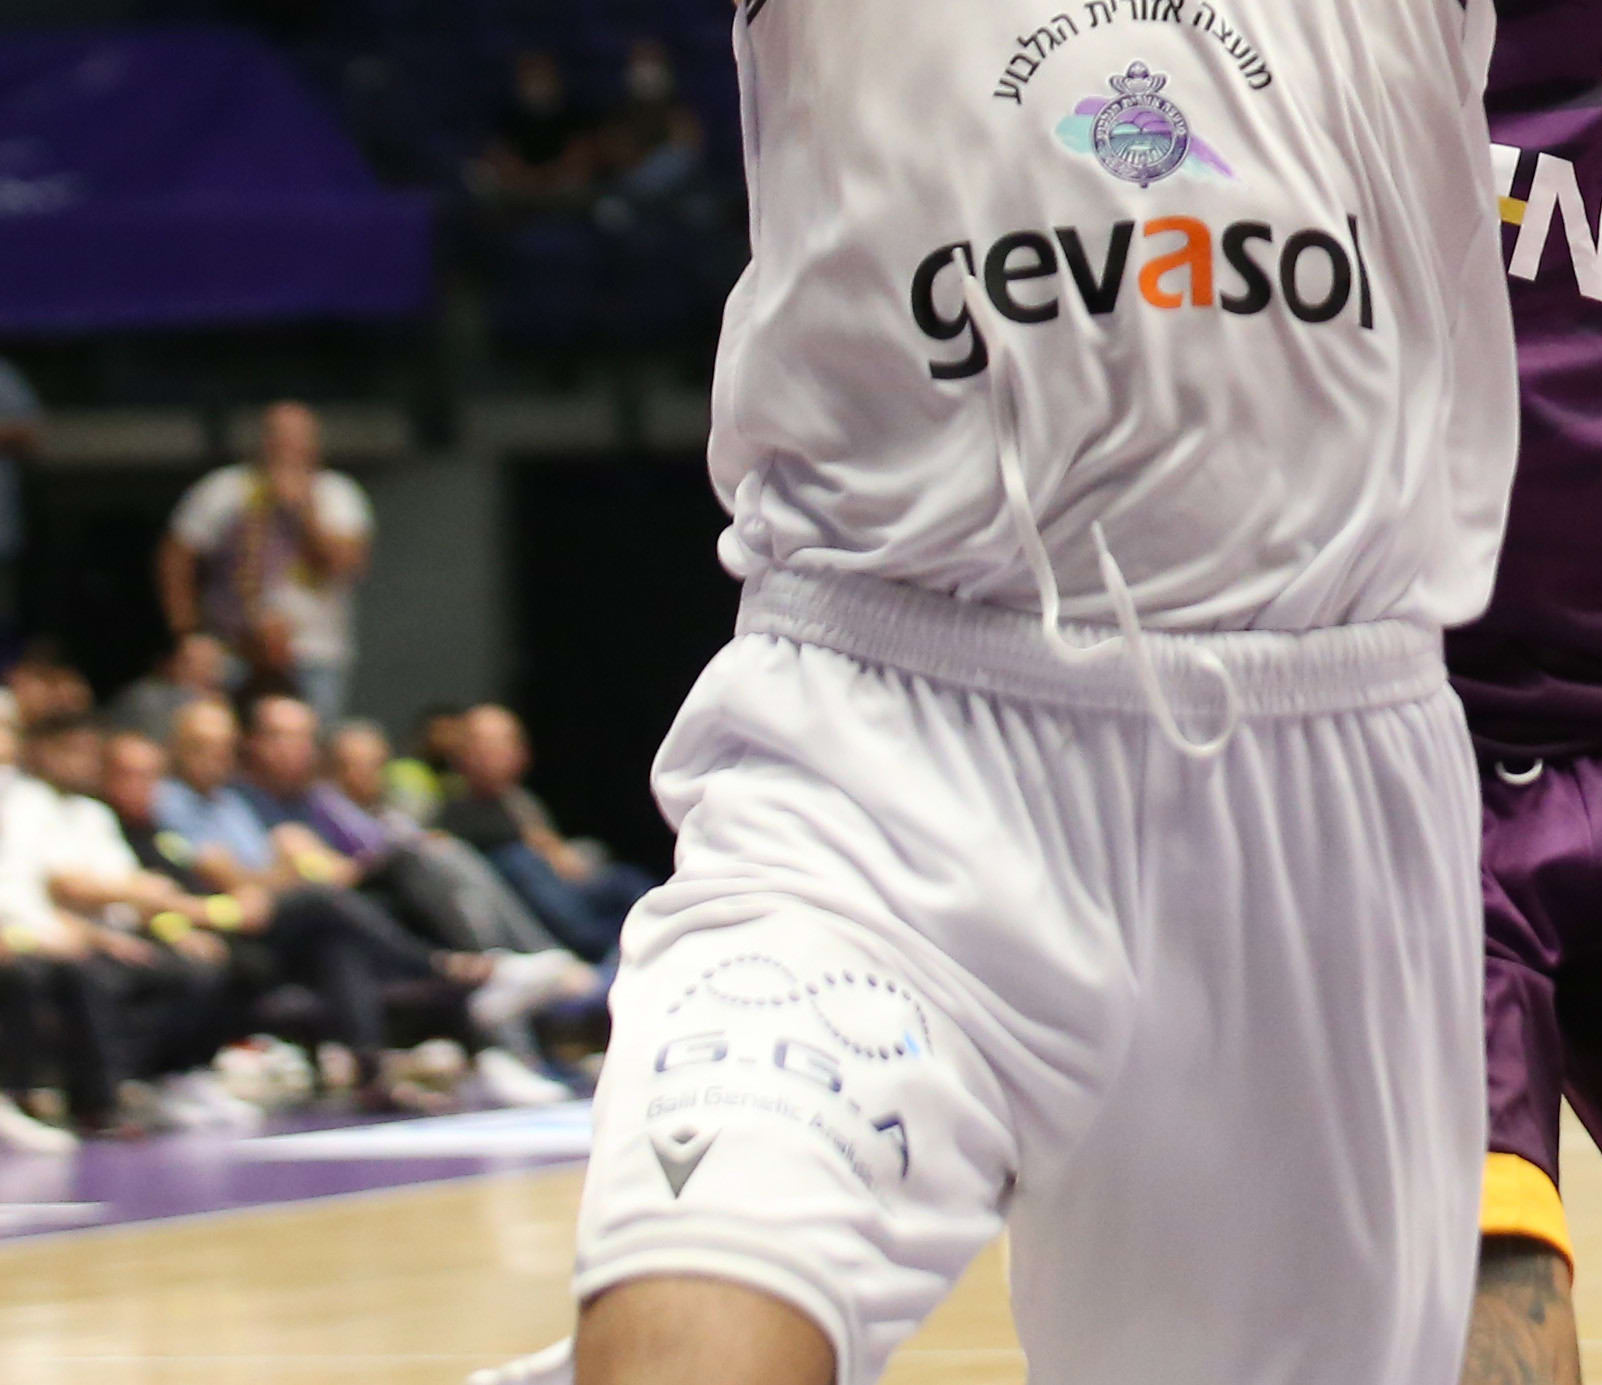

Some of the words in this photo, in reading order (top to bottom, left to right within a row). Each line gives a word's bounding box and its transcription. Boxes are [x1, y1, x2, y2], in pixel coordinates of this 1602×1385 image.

[993, 13, 1080, 105] הגלבוע
[1192, 1, 1273, 91] מועצה
[911, 215, 1373, 380] gevasol
